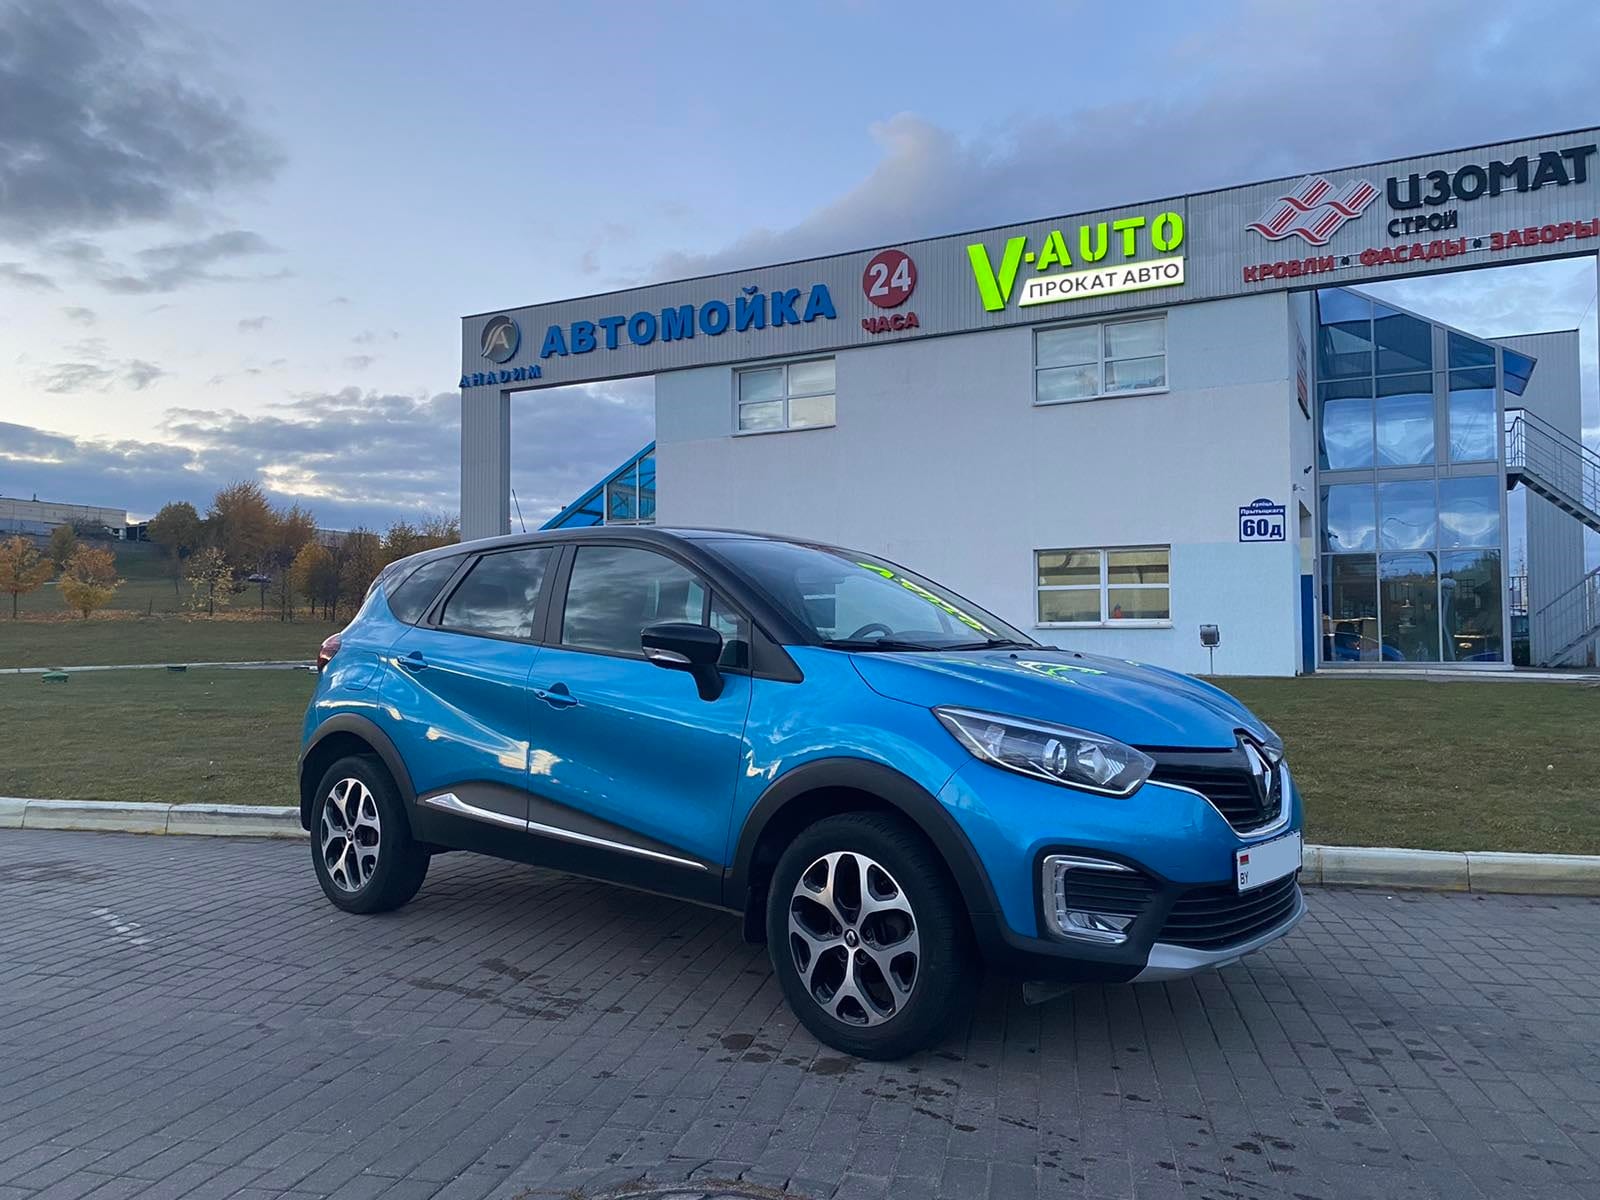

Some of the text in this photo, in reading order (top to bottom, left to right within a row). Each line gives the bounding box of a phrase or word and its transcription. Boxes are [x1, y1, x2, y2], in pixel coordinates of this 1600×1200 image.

[1388, 210, 1458, 238] СТРОЙ
[1243, 218, 1599, 283] КРОВЛИ ФАСАДЫ ЗАБОРЫ
[868, 261, 912, 297] 24
[1029, 263, 1180, 298] ПРОКАТ АВТО
[540, 283, 837, 359] АВТОМОЙКА
[861, 311, 919, 334] ЧАСА
[1240, 871, 1249, 885] BY
